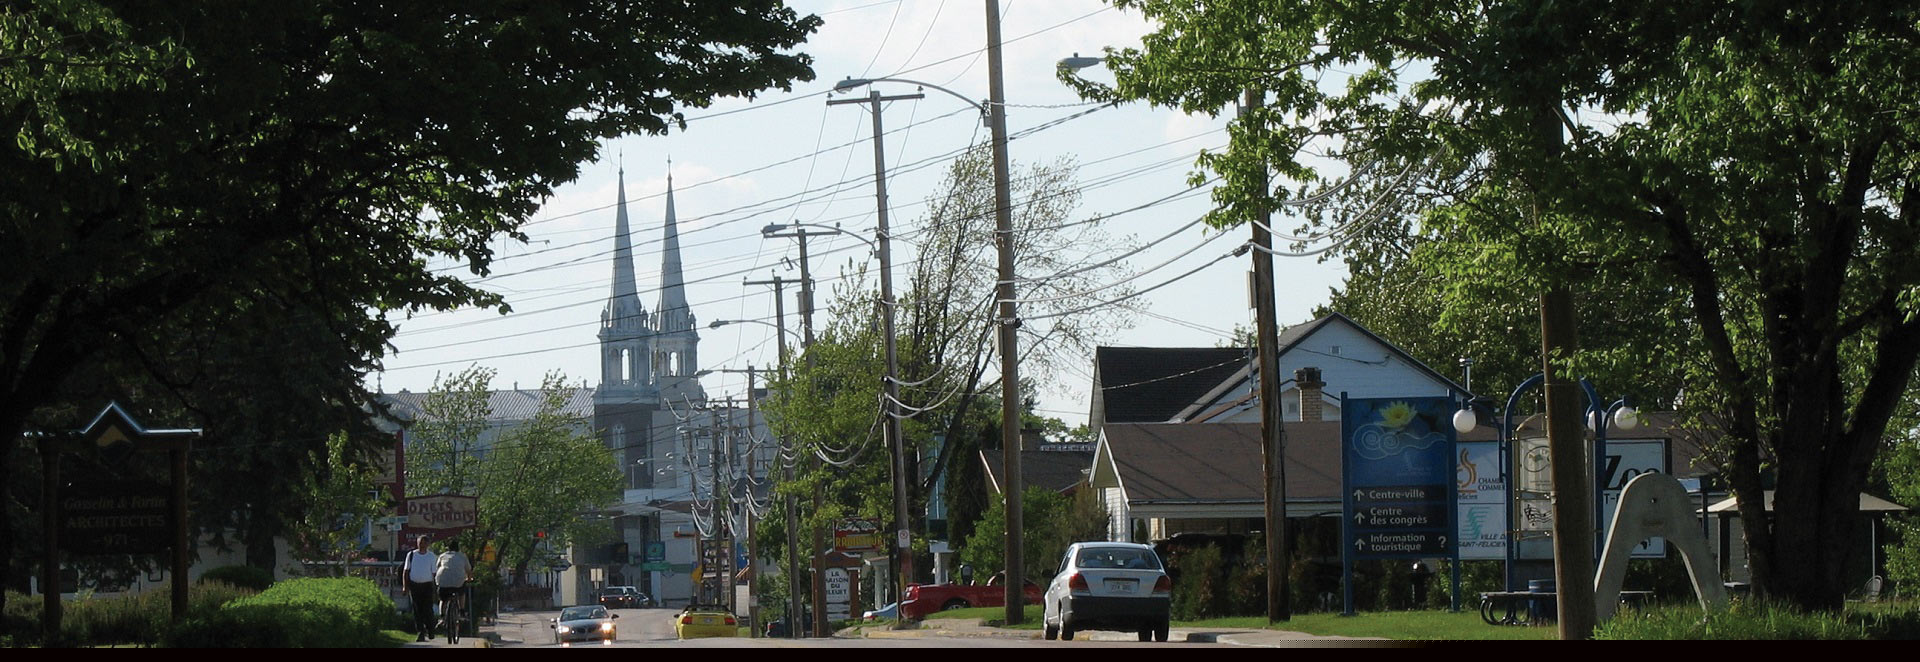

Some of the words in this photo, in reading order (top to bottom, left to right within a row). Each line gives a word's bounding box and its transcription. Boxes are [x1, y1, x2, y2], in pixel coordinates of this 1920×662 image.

[1605, 455, 1660, 490] Zo
[1369, 490, 1425, 499] Centre-ville
[1370, 507, 1403, 516] Centre
[66, 515, 166, 528] ARCHITECTES
[1389, 516, 1428, 527] congrès
[1370, 533, 1426, 543] Information
[1438, 536, 1447, 549] ?
[1371, 542, 1422, 552] touristique
